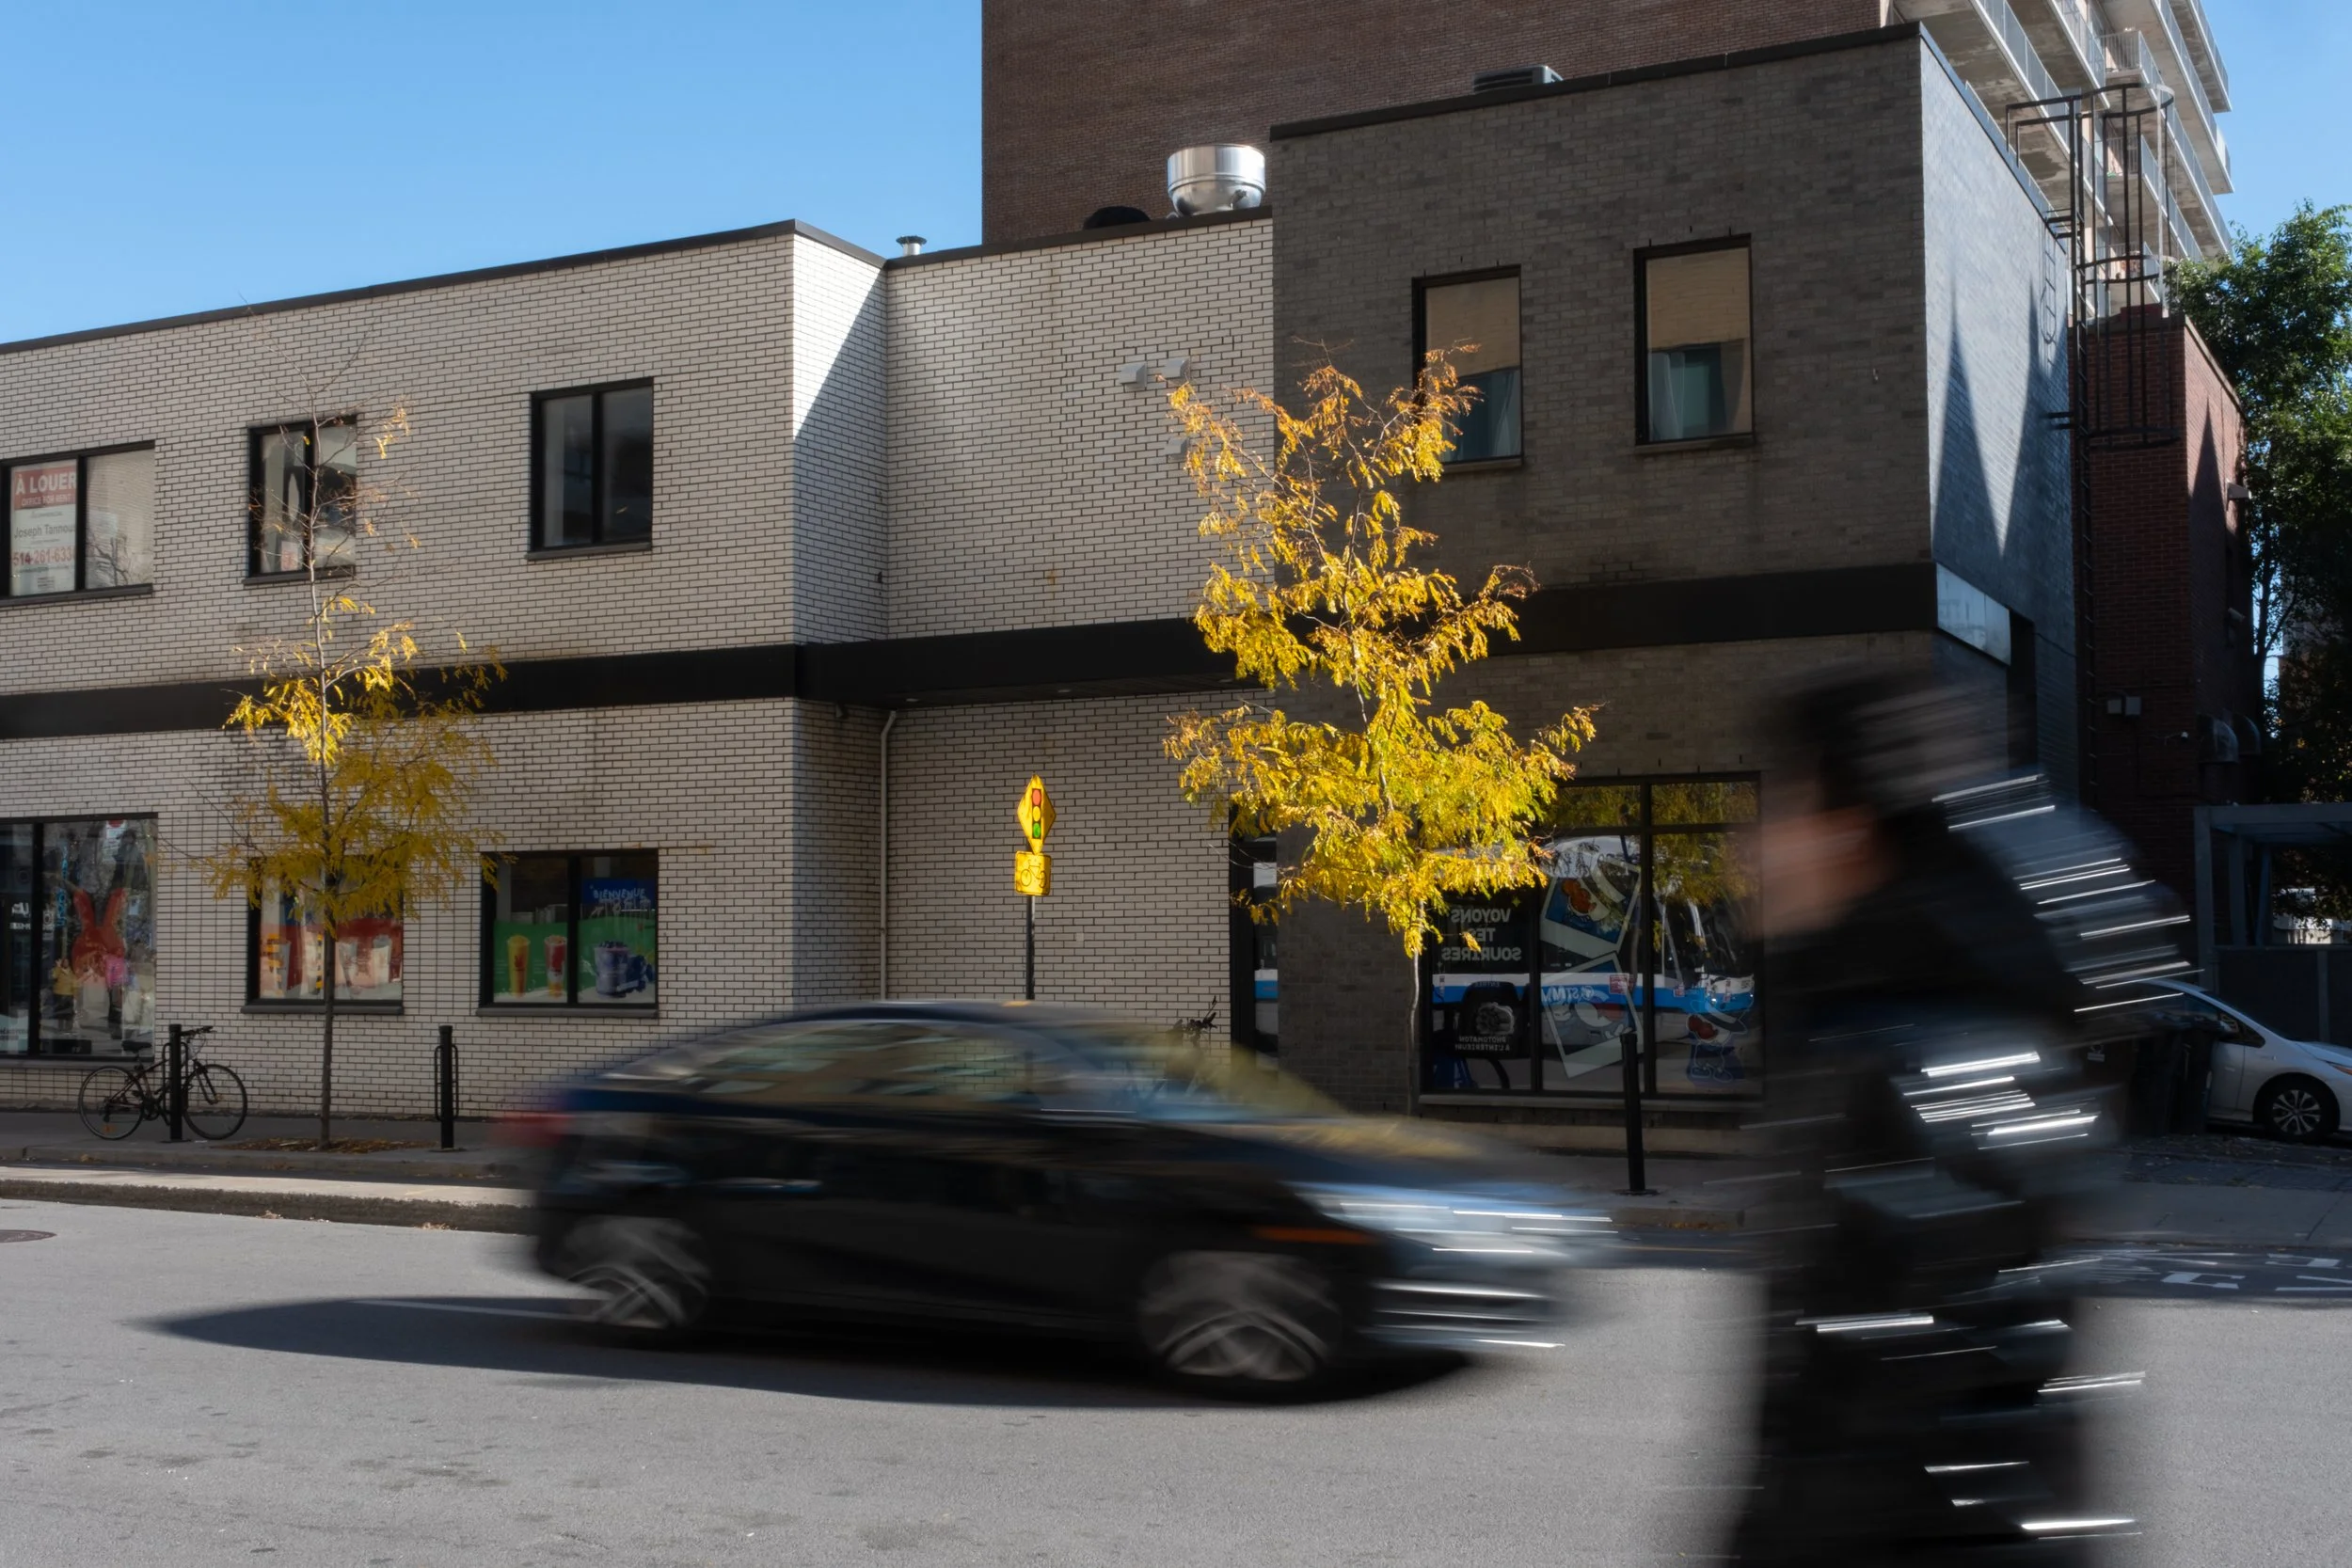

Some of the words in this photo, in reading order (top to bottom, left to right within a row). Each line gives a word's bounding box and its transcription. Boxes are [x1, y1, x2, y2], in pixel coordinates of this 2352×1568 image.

[15, 473, 26, 496] À
[29, 471, 76, 494] LOUER
[42, 495, 55, 504] FOR
[14, 526, 42, 539] Joseph
[593, 888, 645, 899] BIENVENUE
